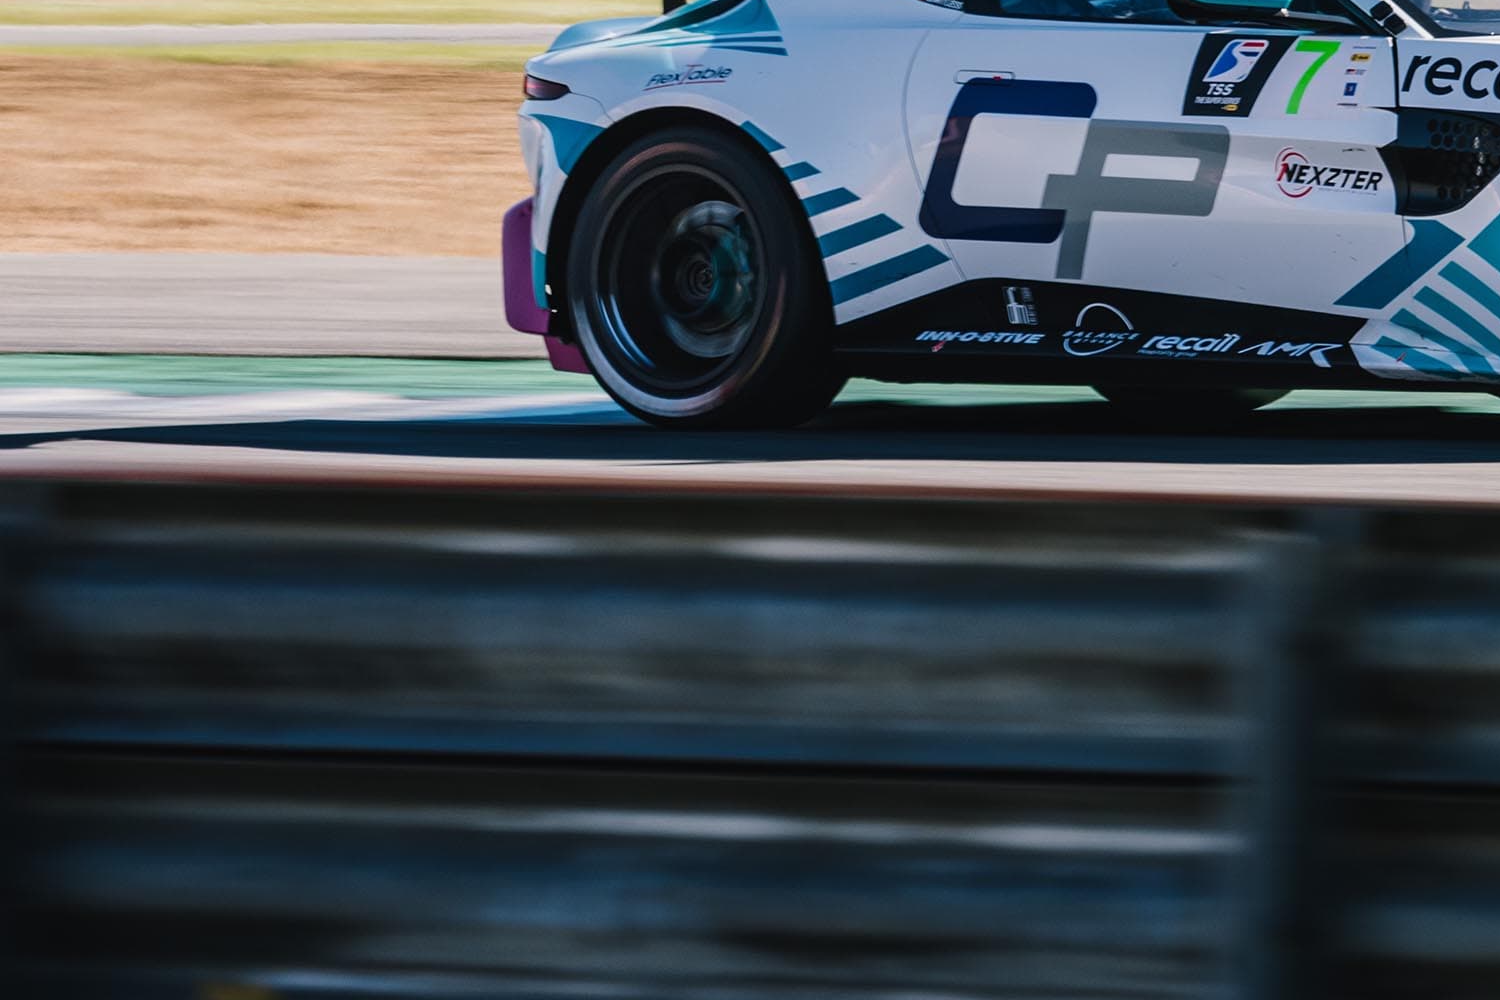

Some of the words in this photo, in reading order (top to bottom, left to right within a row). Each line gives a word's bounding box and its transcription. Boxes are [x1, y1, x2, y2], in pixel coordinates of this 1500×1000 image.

[1285, 40, 1341, 114] 7
[1206, 83, 1235, 96] TSS
[1277, 162, 1384, 191] NEXZTER
[1142, 333, 1241, 353] recall
